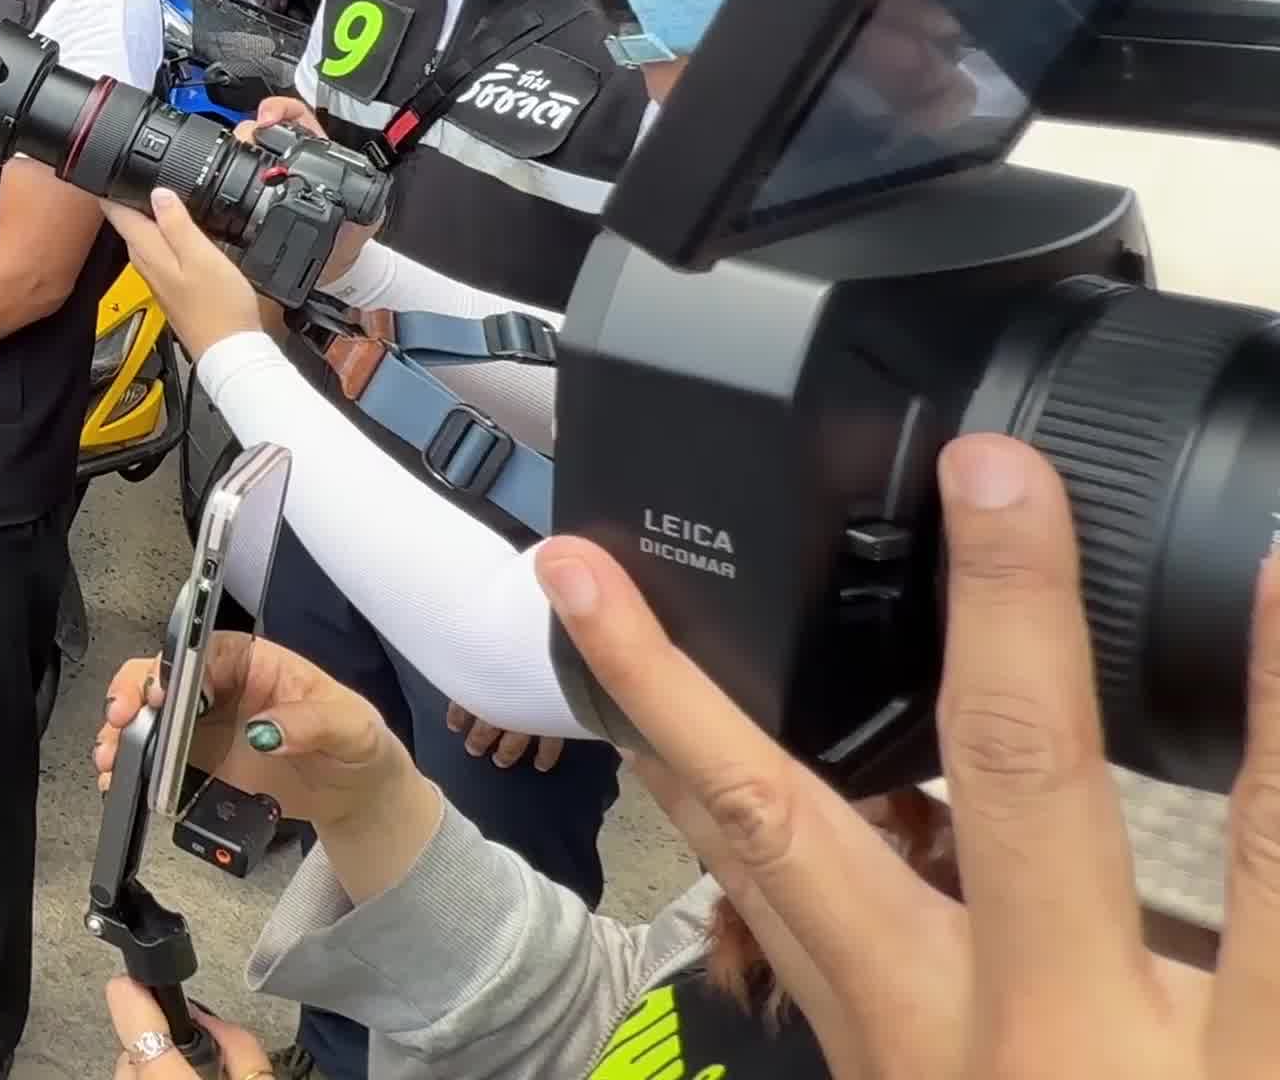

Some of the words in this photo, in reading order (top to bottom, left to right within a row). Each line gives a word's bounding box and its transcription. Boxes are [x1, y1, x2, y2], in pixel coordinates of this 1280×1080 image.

[321, 0, 384, 78] 9
[516, 69, 550, 90] ทีม
[644, 508, 734, 553] LEICA
[640, 536, 736, 579] DICOMAR
